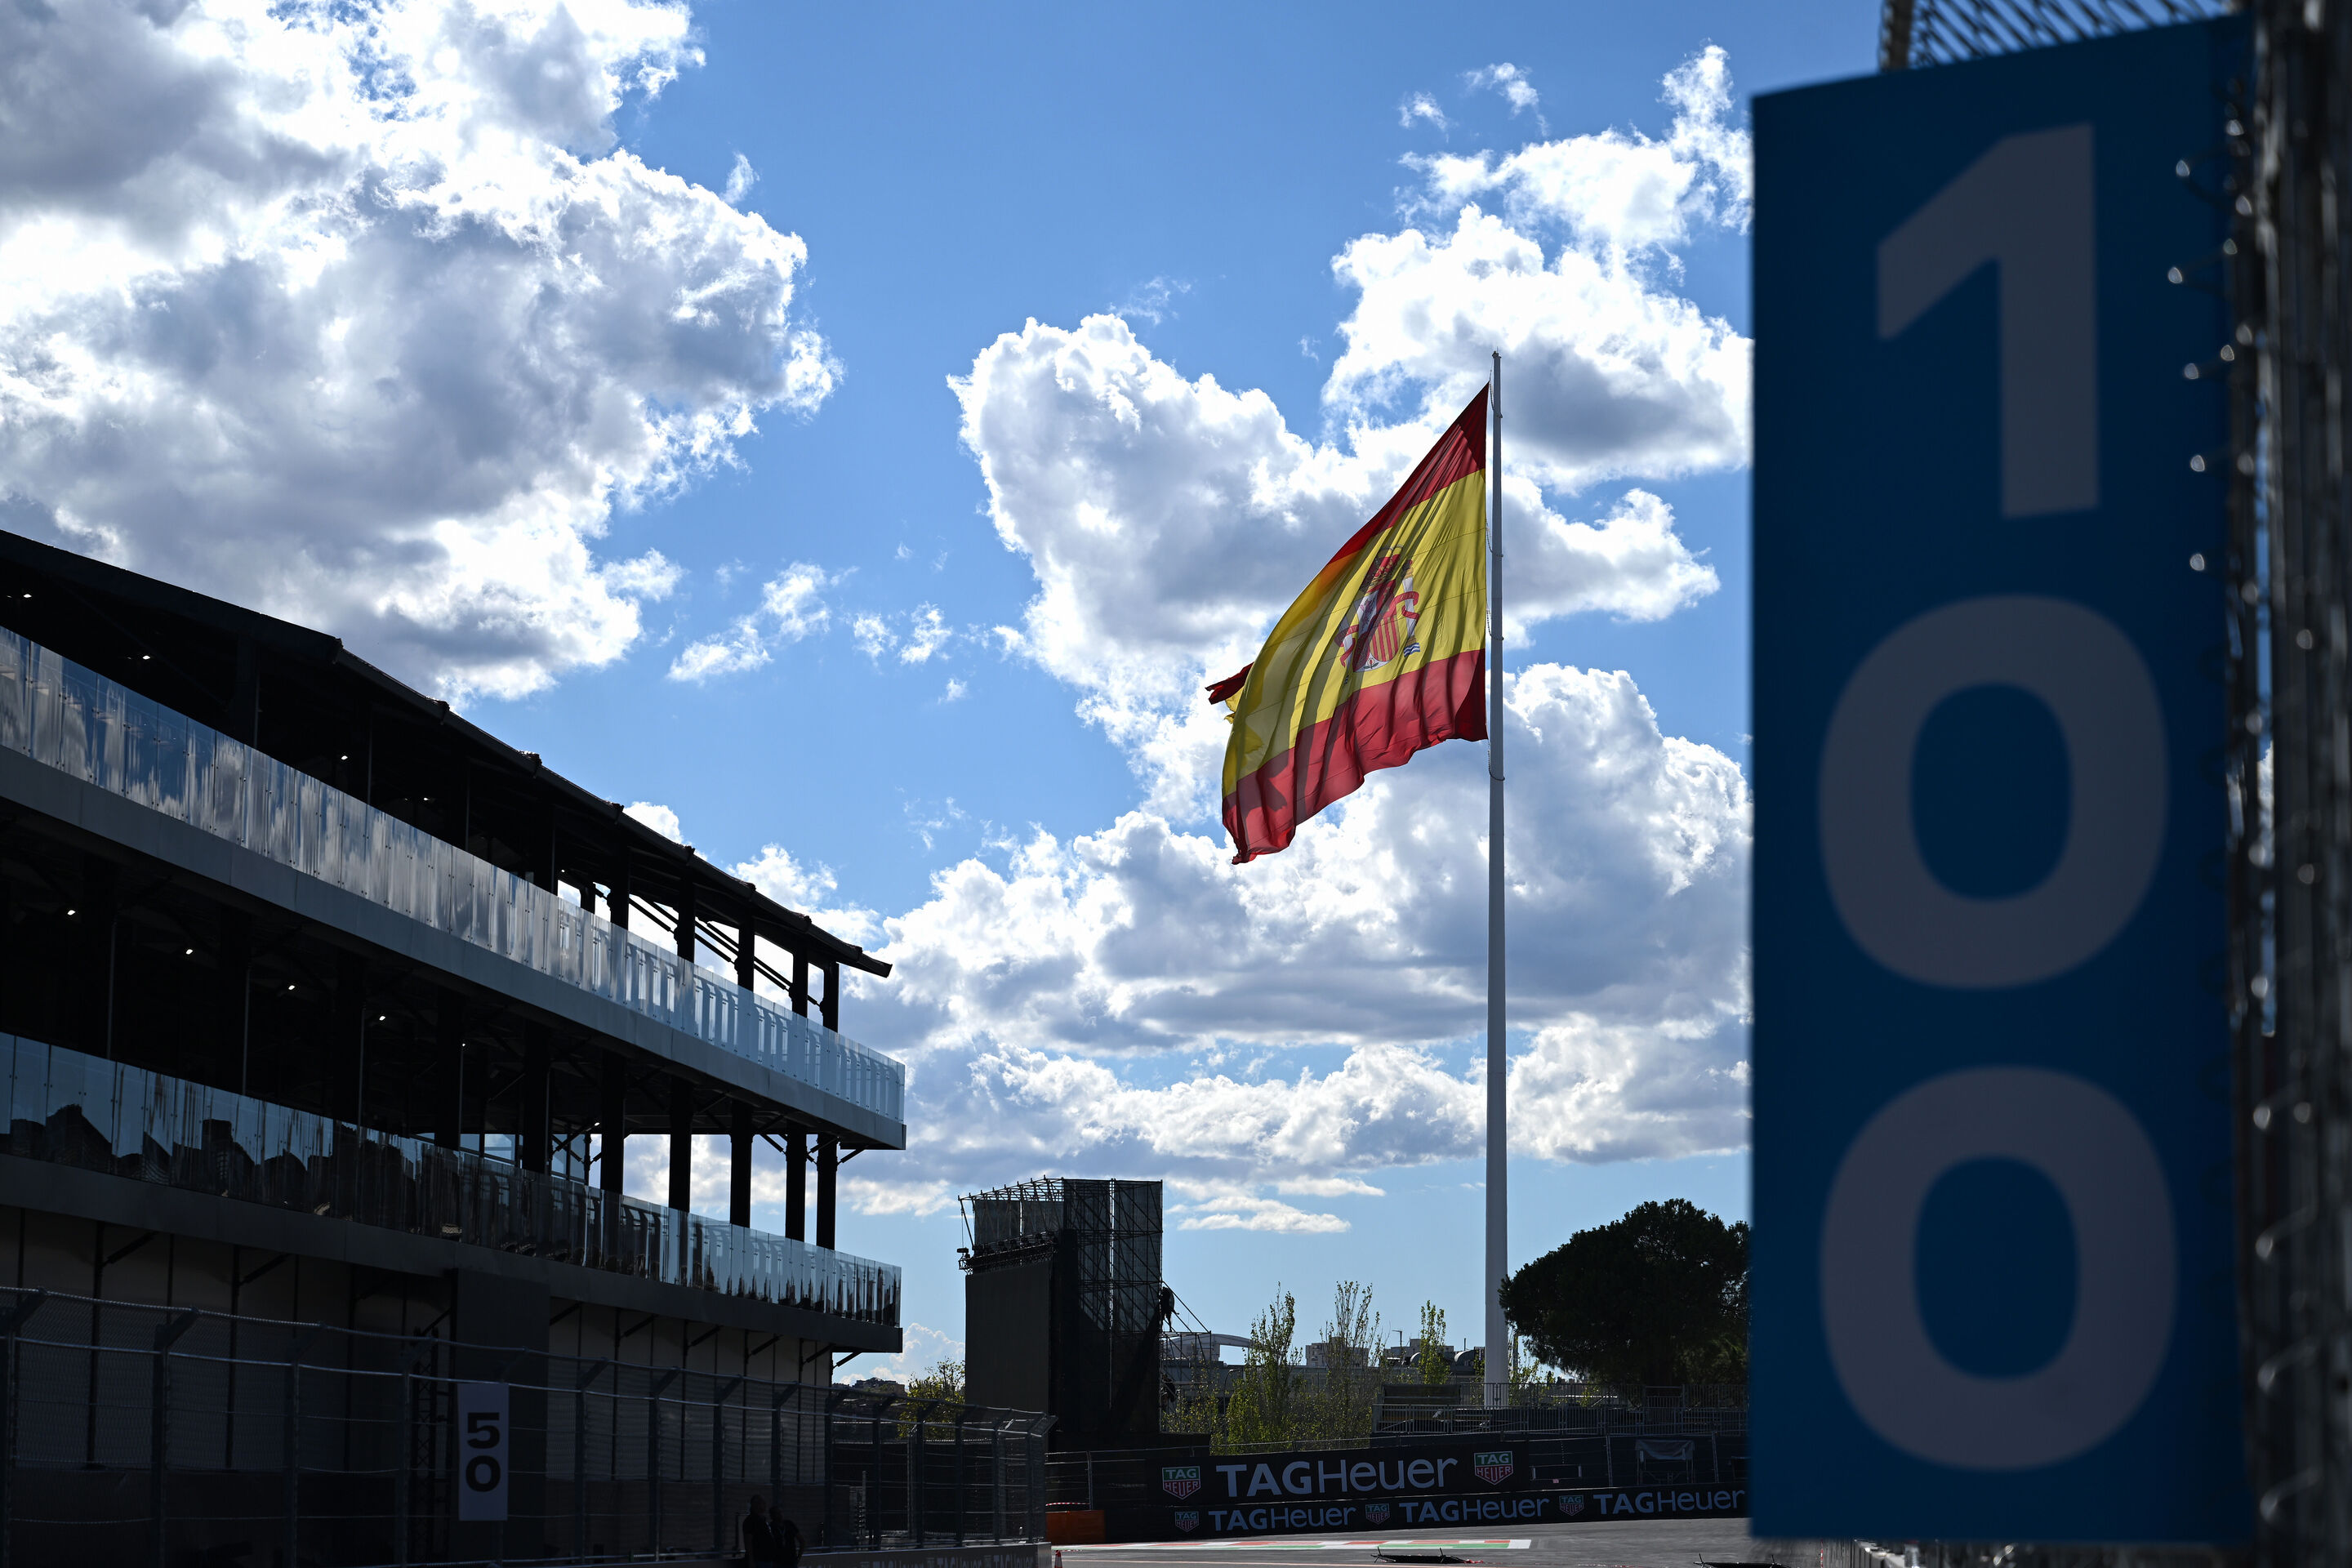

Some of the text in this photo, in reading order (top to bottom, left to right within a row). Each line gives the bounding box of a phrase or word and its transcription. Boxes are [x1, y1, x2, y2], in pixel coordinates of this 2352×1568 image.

[1818, 120, 2179, 1472] 100
[466, 1412, 501, 1492] 50
[1478, 1453, 1509, 1463] TAG
[1165, 1468, 1197, 1479] TAG
[1216, 1459, 1459, 1497] TAGHeuer
[1477, 1465, 1512, 1481] HEUER
[1165, 1481, 1200, 1496] HEUER
[1399, 1497, 1549, 1522] TAGHeuer
[1593, 1490, 1745, 1515] TAGHeuer
[1209, 1507, 1356, 1531] TAGHeuer
